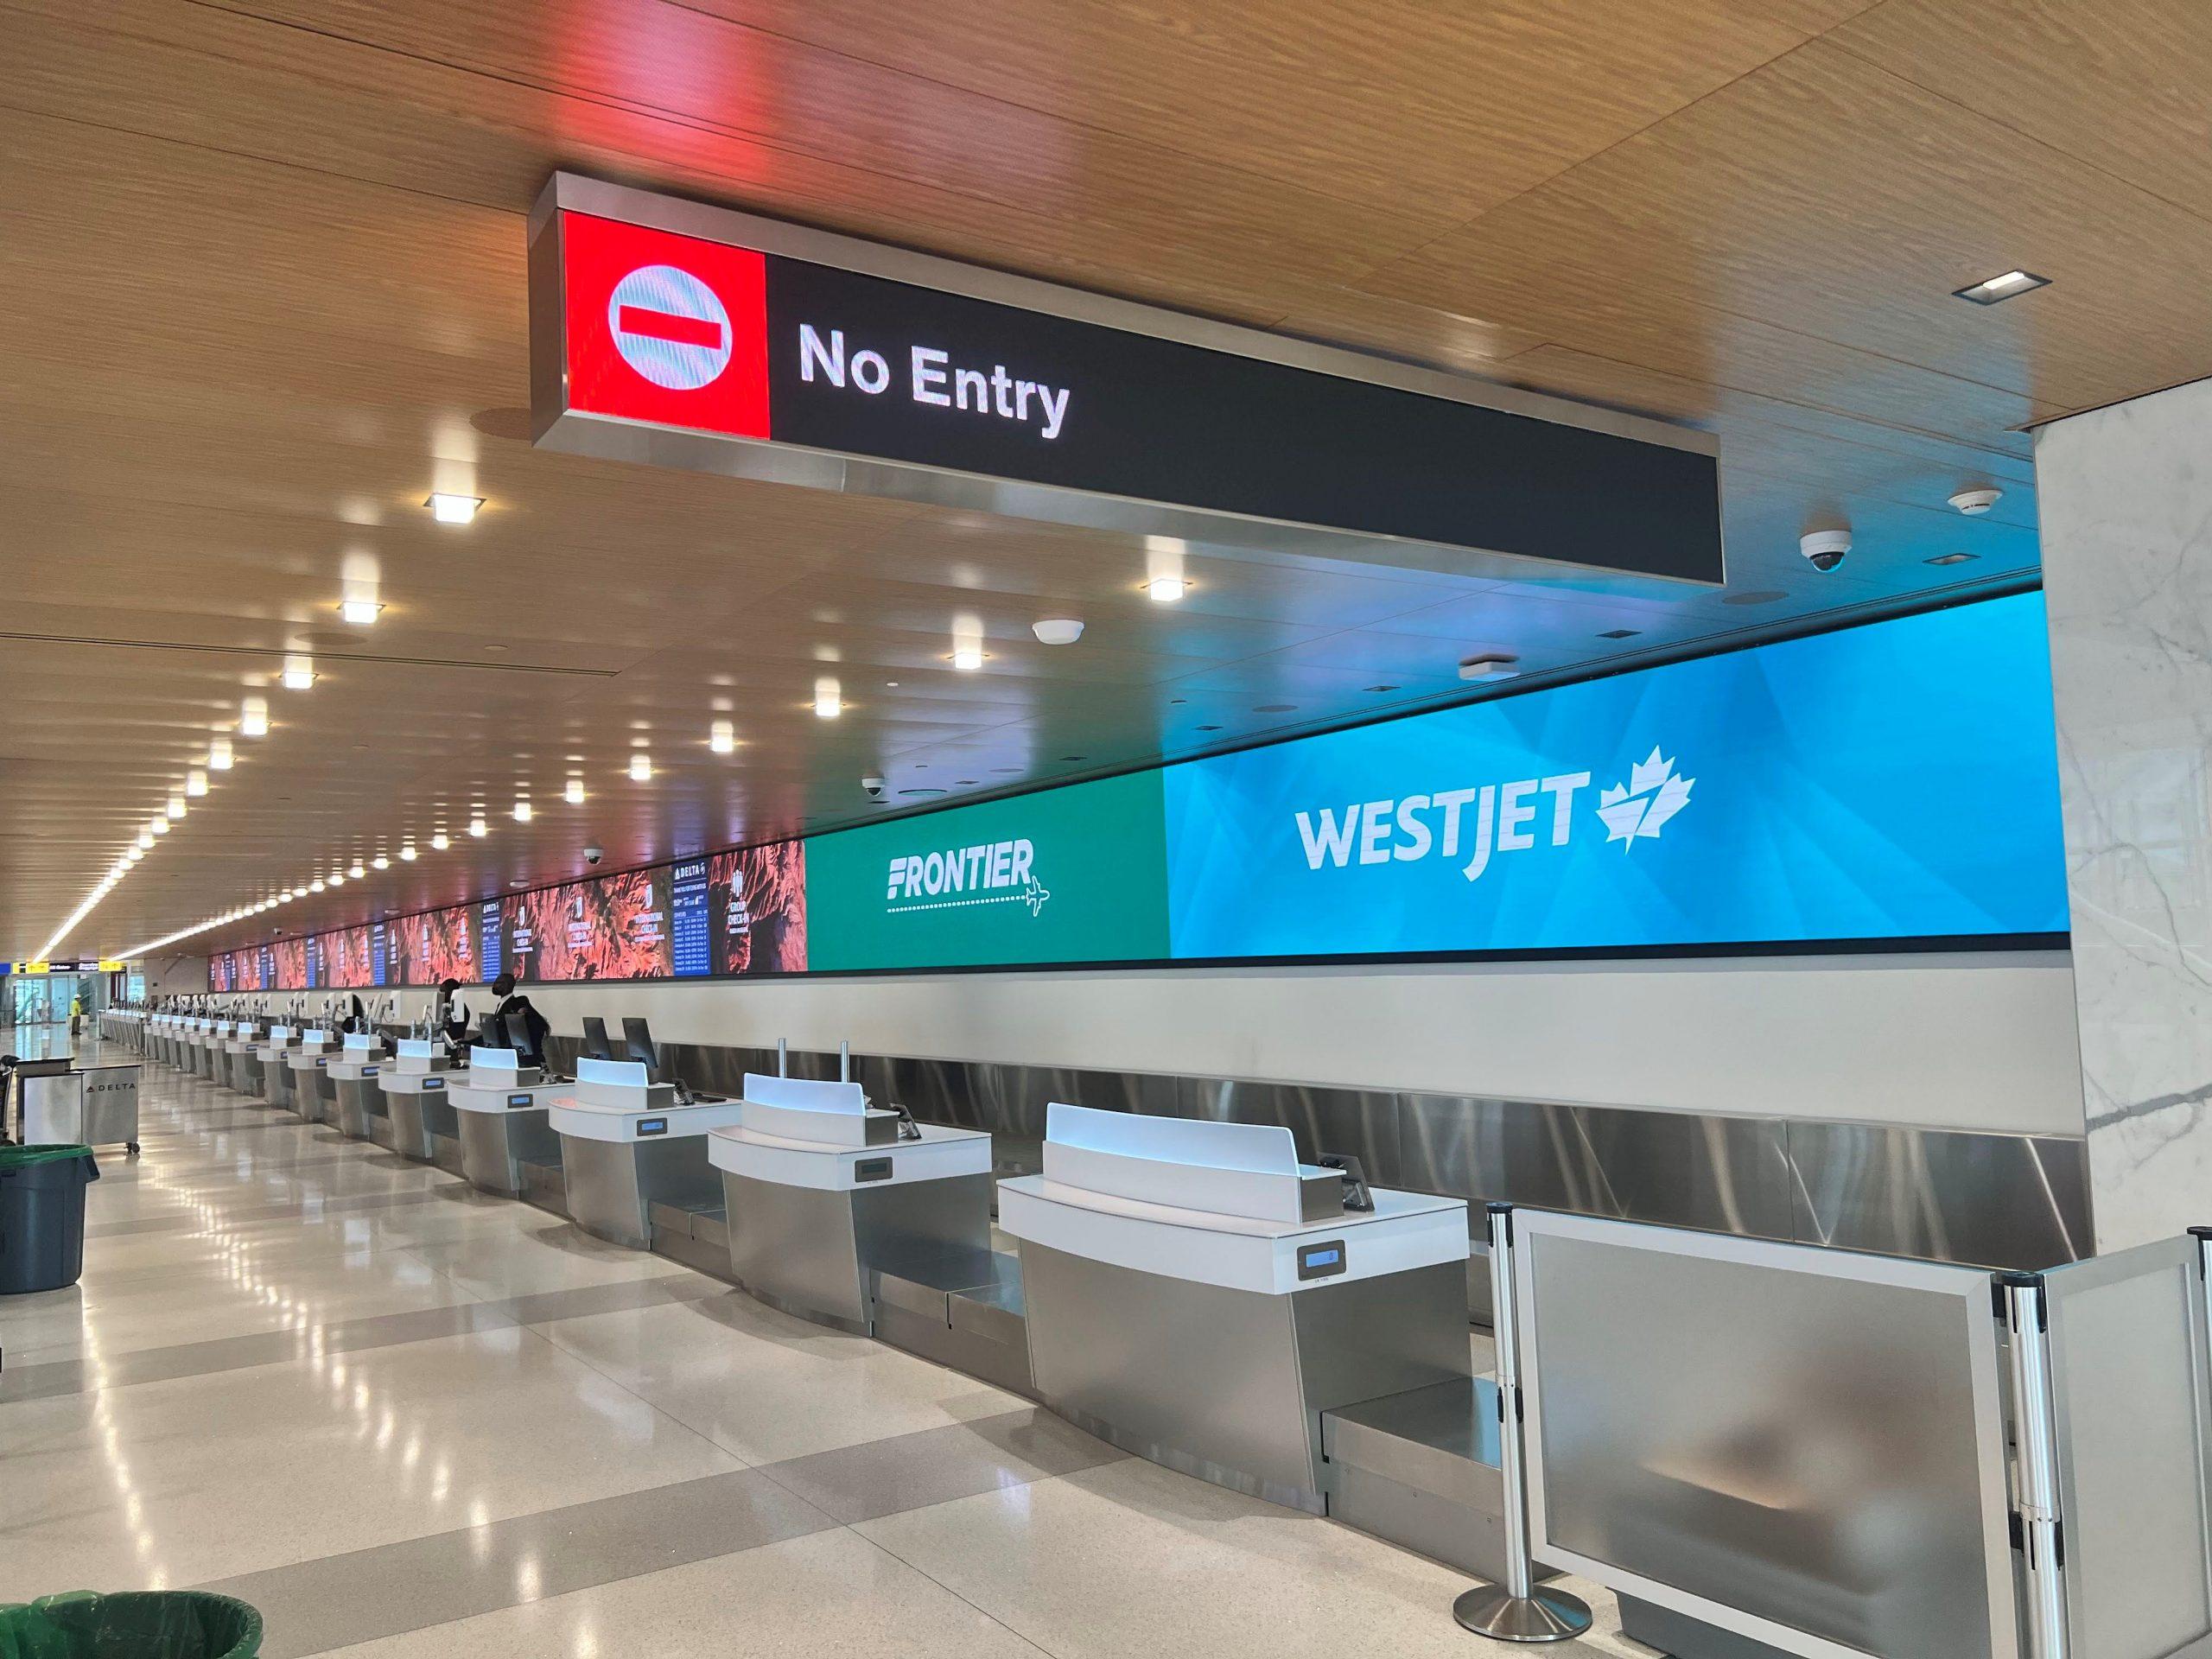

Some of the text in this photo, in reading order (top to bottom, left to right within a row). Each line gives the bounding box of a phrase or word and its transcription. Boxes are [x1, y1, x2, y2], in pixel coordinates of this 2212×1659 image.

[799, 323, 1071, 440] No Entry
[887, 838, 1034, 899] FRONTIER
[1294, 771, 1592, 882] WESTJET
[98, 1083, 136, 1091] DELTA
